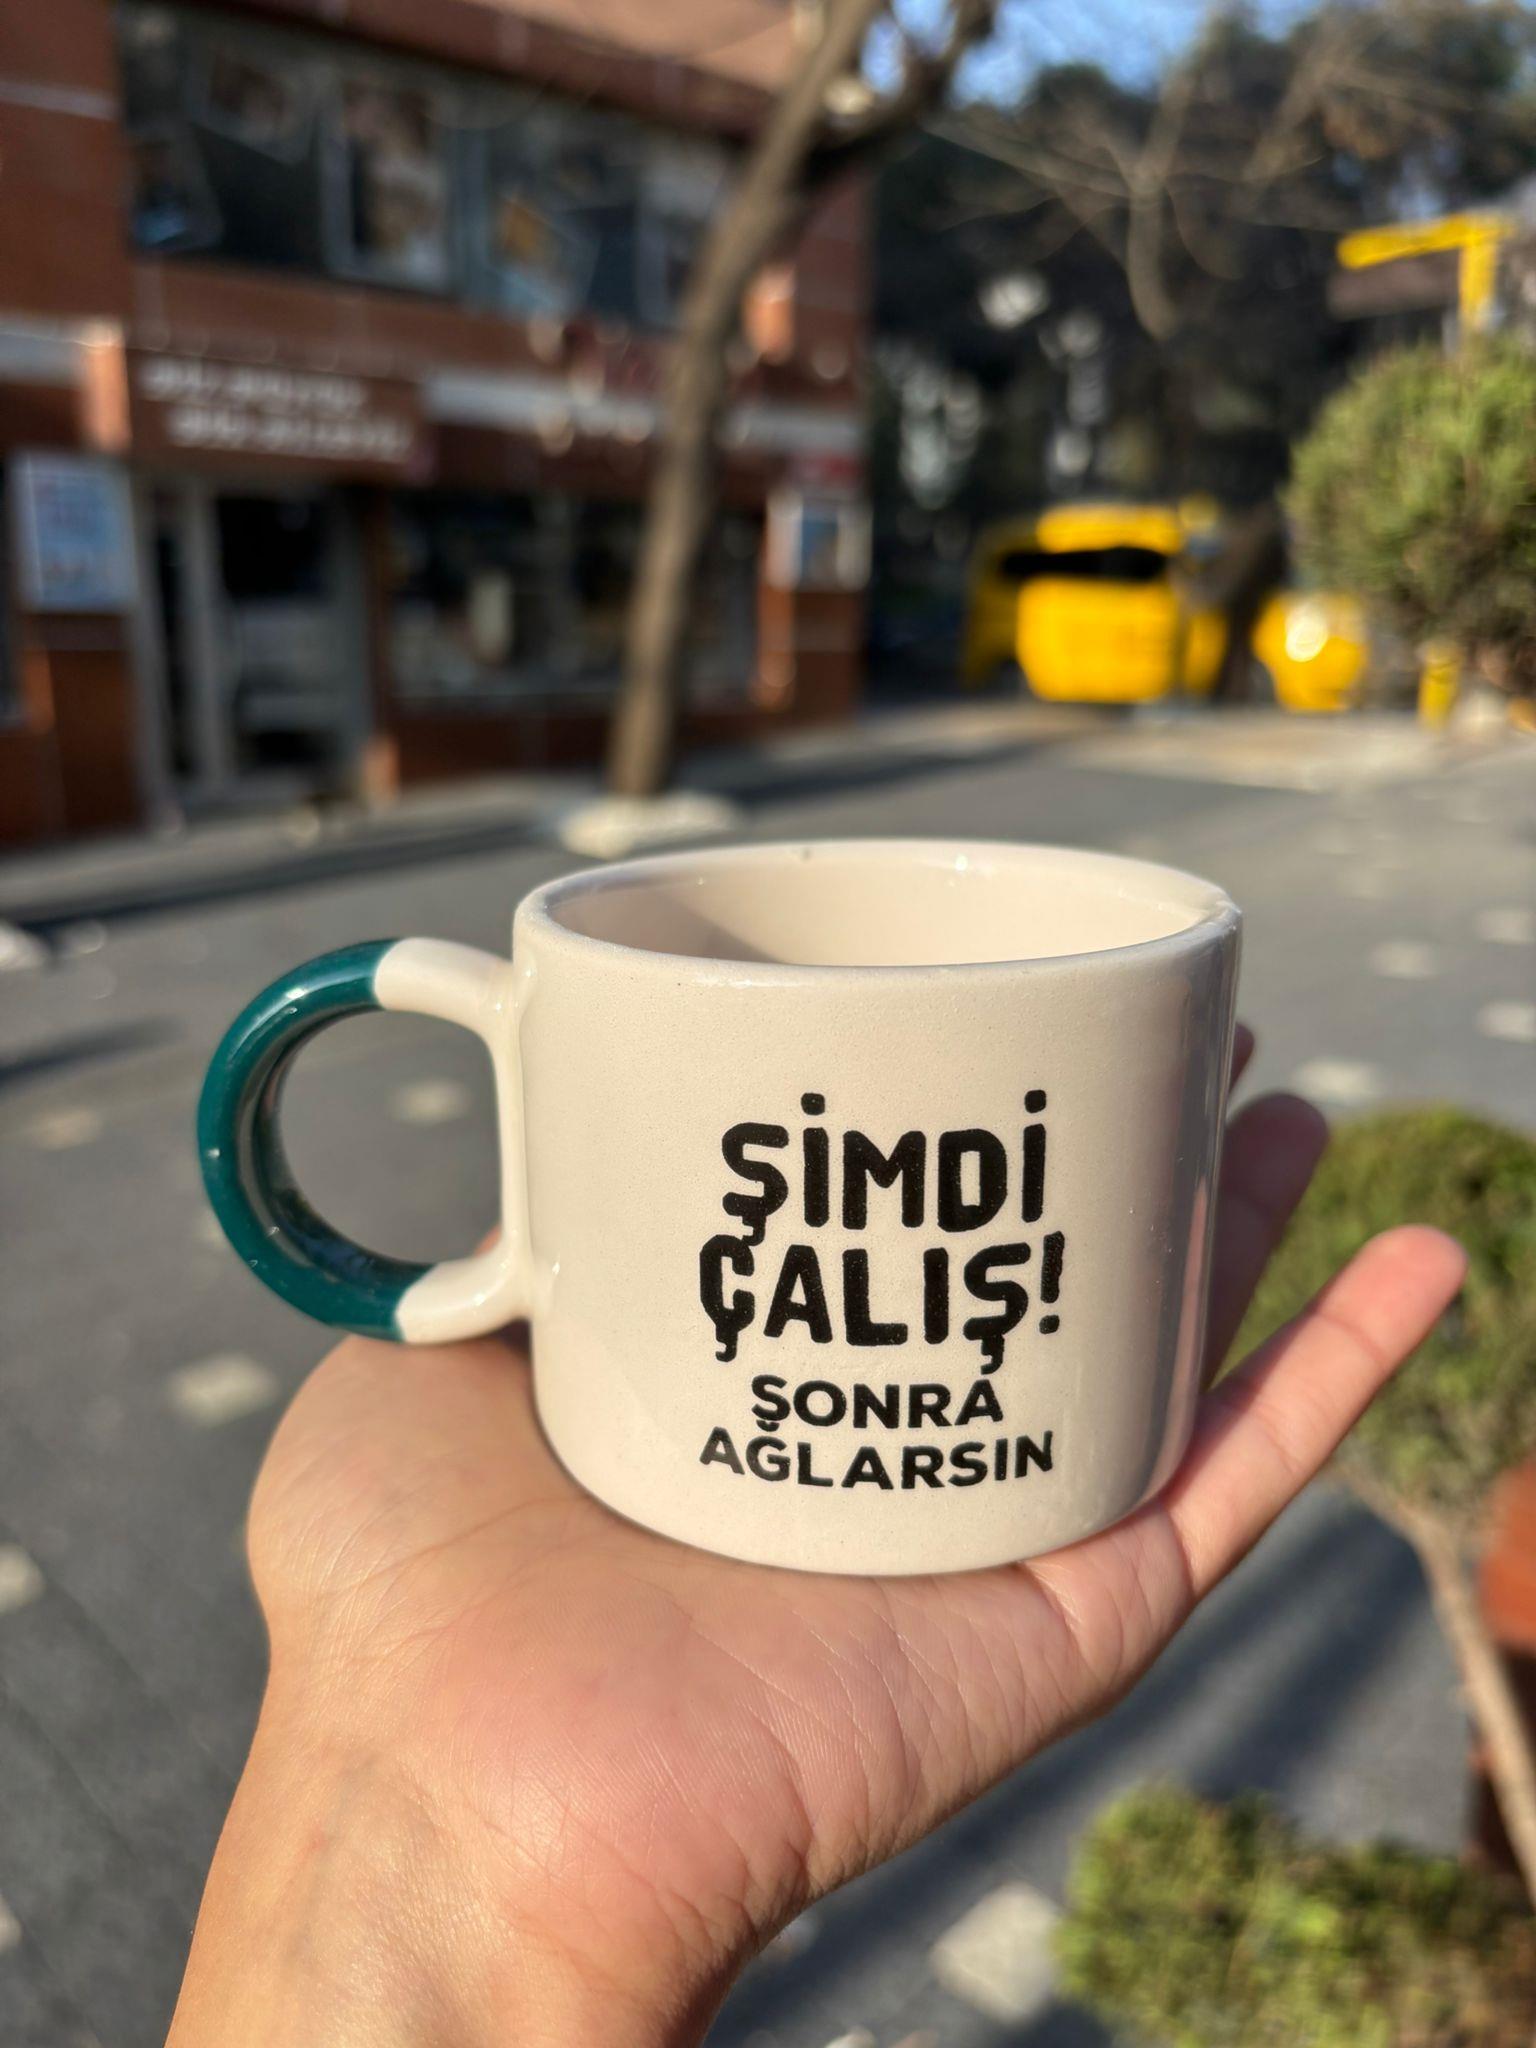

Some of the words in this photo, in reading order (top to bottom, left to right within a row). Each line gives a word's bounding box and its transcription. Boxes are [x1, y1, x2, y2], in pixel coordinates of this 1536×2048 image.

[721, 1089, 1047, 1246] ŞİMDİ
[699, 1230, 1065, 1375] ÇALIŞ!
[699, 1419, 1054, 1490] AĞLARSIN
[751, 1374, 1004, 1429] SONRA
